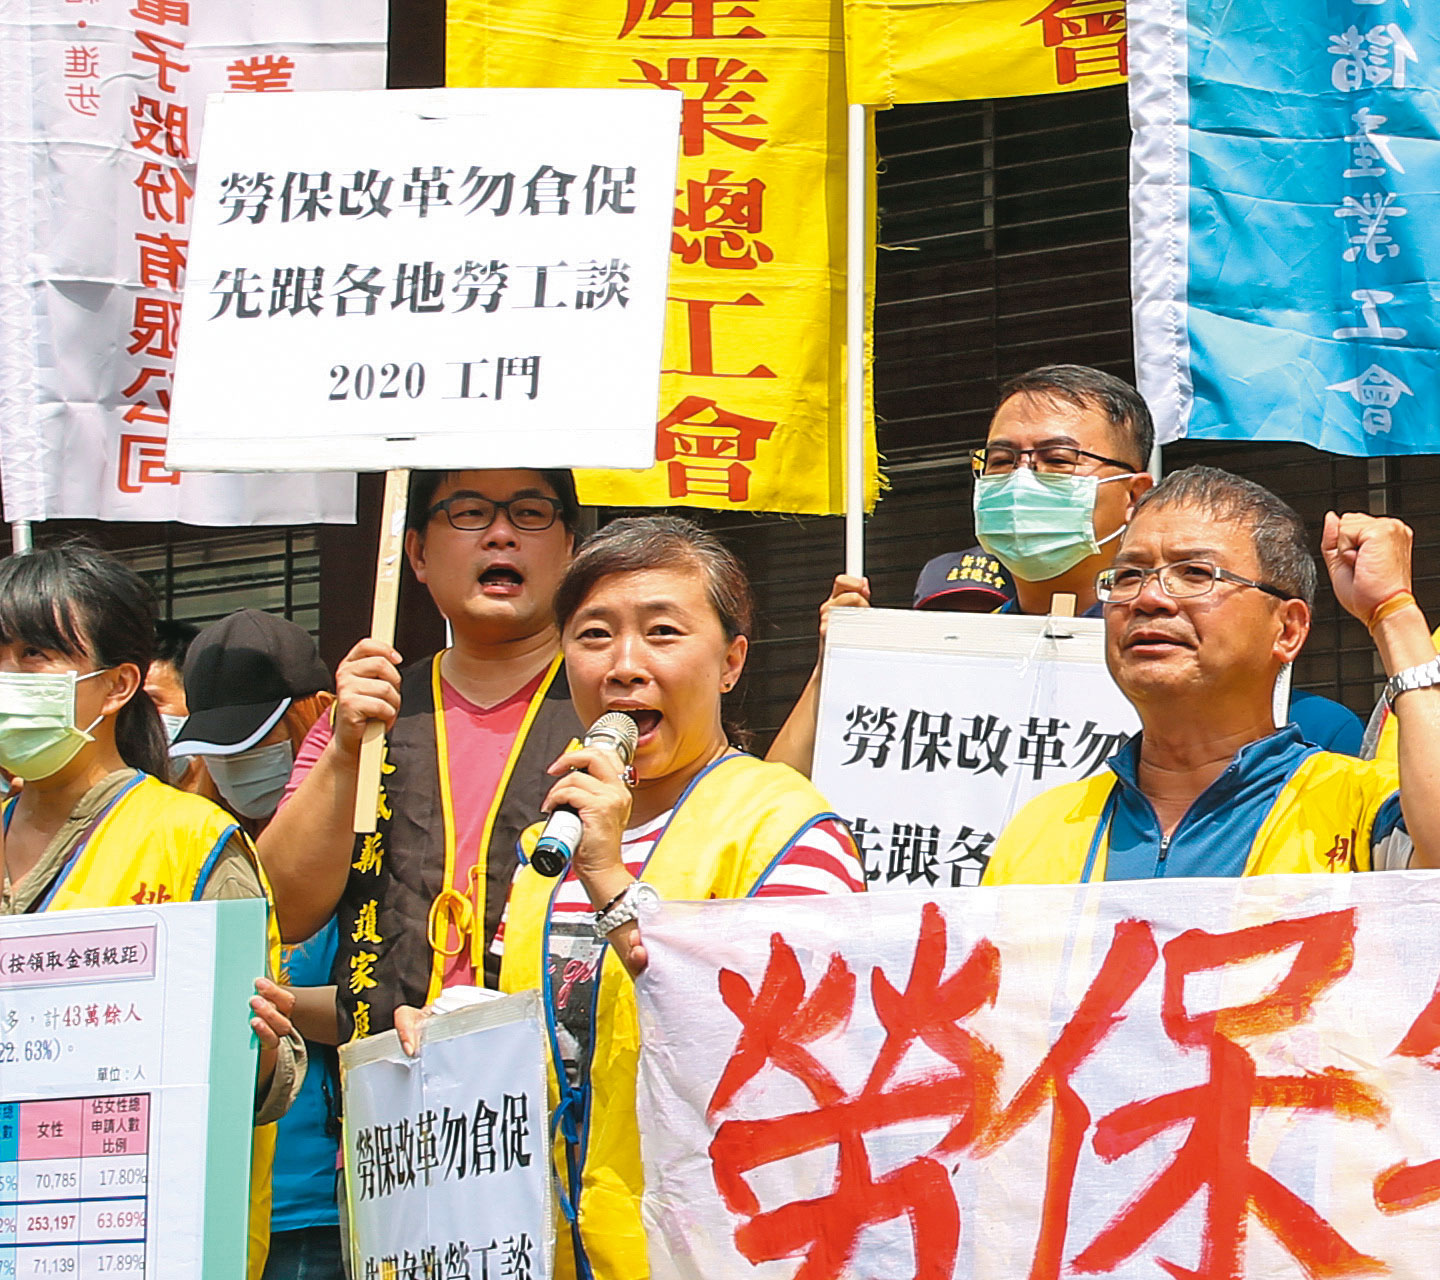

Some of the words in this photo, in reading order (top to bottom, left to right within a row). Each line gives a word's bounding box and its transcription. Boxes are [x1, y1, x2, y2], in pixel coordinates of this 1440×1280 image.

[217, 164, 638, 226] 勞保改革勿倉促
[207, 258, 632, 321] 先跟各地勞工談
[328, 362, 427, 401] 2020
[841, 705, 1132, 780] 勞保改革勿
[37, 1121, 64, 1139] 女性
[102, 1138, 127, 1155] 比例
[357, 1092, 531, 1201] 勞保改革勿倉促
[36, 1173, 77, 1189] 70,785
[99, 1168, 147, 1186] 17.80%
[27, 1215, 76, 1232] 253,197
[97, 1211, 146, 1229] 63.69%
[33, 1258, 75, 1274] 71,139
[97, 1255, 145, 1272] 17.89%
